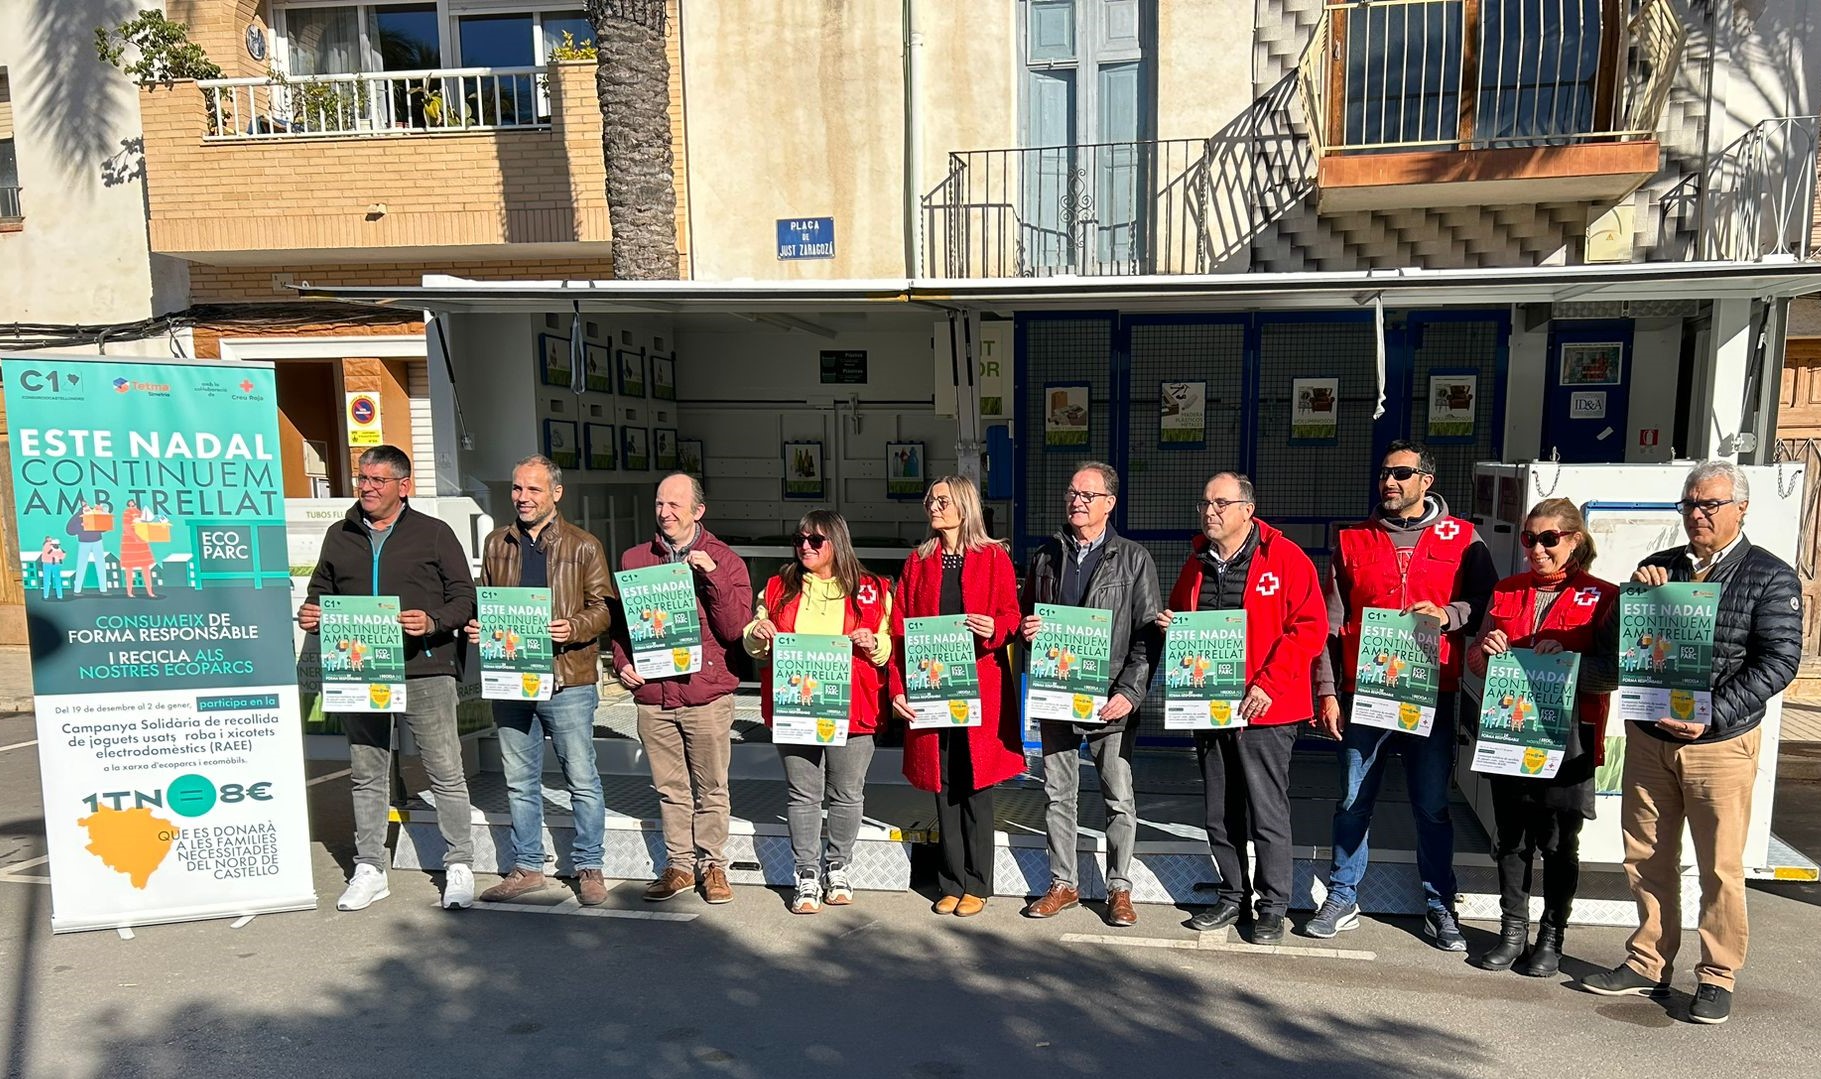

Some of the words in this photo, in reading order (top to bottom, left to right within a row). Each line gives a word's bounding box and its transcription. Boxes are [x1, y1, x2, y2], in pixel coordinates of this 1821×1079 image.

[802, 233, 810, 241] DE
[780, 244, 796, 257] JUST
[799, 241, 833, 256] ZARAGOZÁ
[20, 370, 59, 392] C1
[19, 429, 113, 457] ESTE
[128, 432, 273, 460] NADAL
[22, 459, 274, 488] CONTINUEM
[23, 488, 114, 515] AMB
[128, 489, 278, 516] TRELLAT
[306, 511, 331, 519] TUBOS
[202, 531, 240, 545] ECO
[203, 545, 249, 560] PARC
[623, 585, 649, 596] ESTE
[652, 581, 691, 593] NADAL
[625, 590, 692, 606] CONTINUEM
[481, 605, 505, 615] ESTE
[509, 605, 548, 616] NADAL
[1624, 604, 1656, 615] ESTE
[1661, 605, 1712, 616] NADAL
[95, 614, 205, 629] CONSUMEIX
[208, 613, 231, 627] DE
[323, 614, 350, 624] ESTE
[481, 615, 547, 625] CONTINUEM
[1624, 616, 1710, 628] CONTINUEM
[68, 629, 136, 644] FORMA
[139, 625, 259, 642] RESPONSABLE
[323, 624, 398, 634] CONTINUEM
[1066, 624, 1108, 638] NADAL
[1169, 630, 1195, 640] ESTE
[1200, 629, 1244, 640] NADAL
[1365, 626, 1393, 637] ESTE
[1398, 629, 1438, 645] NADAL
[907, 635, 931, 644] ESTE
[934, 633, 971, 644] NADAL
[1036, 632, 1107, 647] CONTINUEM
[1169, 639, 1243, 650] CONTINUEM
[1363, 636, 1437, 654] CONTINUEM
[109, 651, 114, 665] I
[119, 649, 191, 665] RECICLA
[195, 648, 224, 662] ALS
[776, 650, 803, 660] ESTE
[807, 651, 849, 662] NADAL
[908, 643, 971, 654] CONTINUEM
[79, 664, 160, 680] NOSTRES
[164, 661, 254, 677] ECOPARCS
[777, 660, 849, 671] CONTINUEM
[1490, 666, 1520, 678] ESTE
[1525, 669, 1573, 684] NADAL
[1489, 677, 1572, 695] CONTINUEM
[55, 706, 69, 714] Del
[97, 703, 135, 712] desembre
[137, 702, 145, 710] al
[155, 702, 165, 710] de
[200, 698, 247, 710] participa
[265, 696, 275, 705] la
[62, 723, 136, 735] Campanya
[141, 718, 200, 730] Solidària
[204, 716, 220, 727] de
[224, 713, 279, 725] recollida
[68, 736, 85, 747] de
[90, 735, 139, 749] joguets
[185, 729, 216, 740] roba
[227, 727, 275, 738] xicotets
[96, 743, 206, 758] electrodomèstics
[210, 739, 252, 754] (RAEE)
[123, 763, 149, 771] xarxa
[82, 789, 163, 813] 1TN
[220, 782, 273, 803] 8€
[158, 829, 189, 841] QUE
[194, 827, 209, 839] ES
[214, 820, 276, 837] DONARÀ
[176, 841, 186, 851] A
[191, 838, 212, 849] LES
[217, 833, 277, 847] FAMILIES
[178, 844, 278, 861] NECESSITADES
[187, 860, 211, 872] DEL
[215, 857, 257, 869] NORD
[261, 854, 279, 865] DE
[214, 865, 279, 880] CASTELLO
